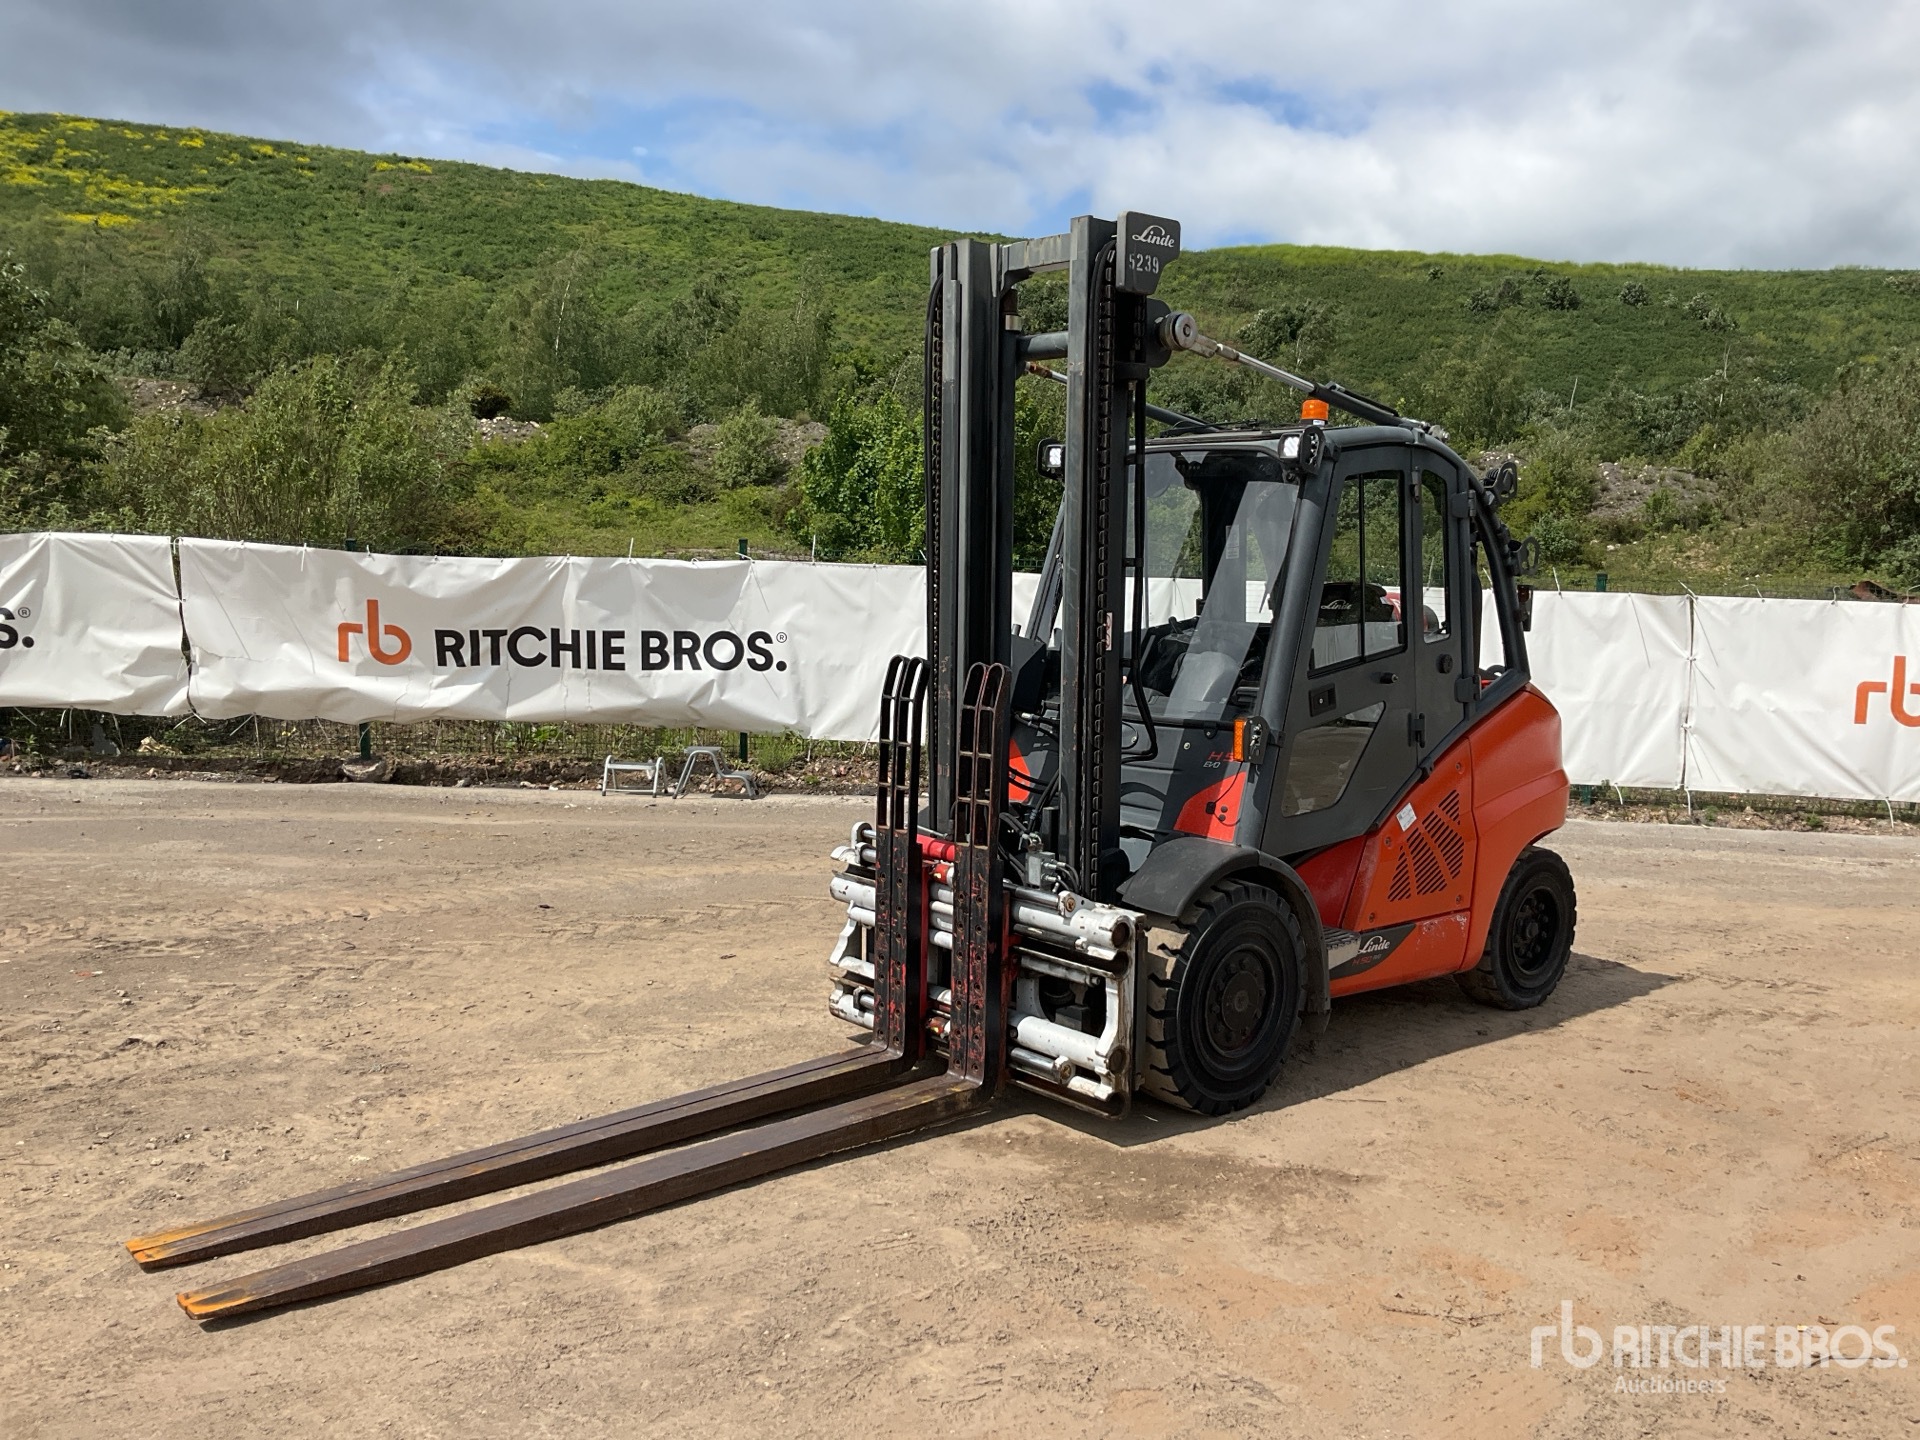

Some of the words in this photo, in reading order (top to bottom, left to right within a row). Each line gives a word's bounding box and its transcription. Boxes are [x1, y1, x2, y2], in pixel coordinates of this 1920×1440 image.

[1132, 225, 1174, 247] Linde
[1129, 254, 1159, 274] 5239
[338, 600, 411, 665] rb
[435, 627, 625, 670] RITCHIE
[1359, 936, 1390, 953] Linde
